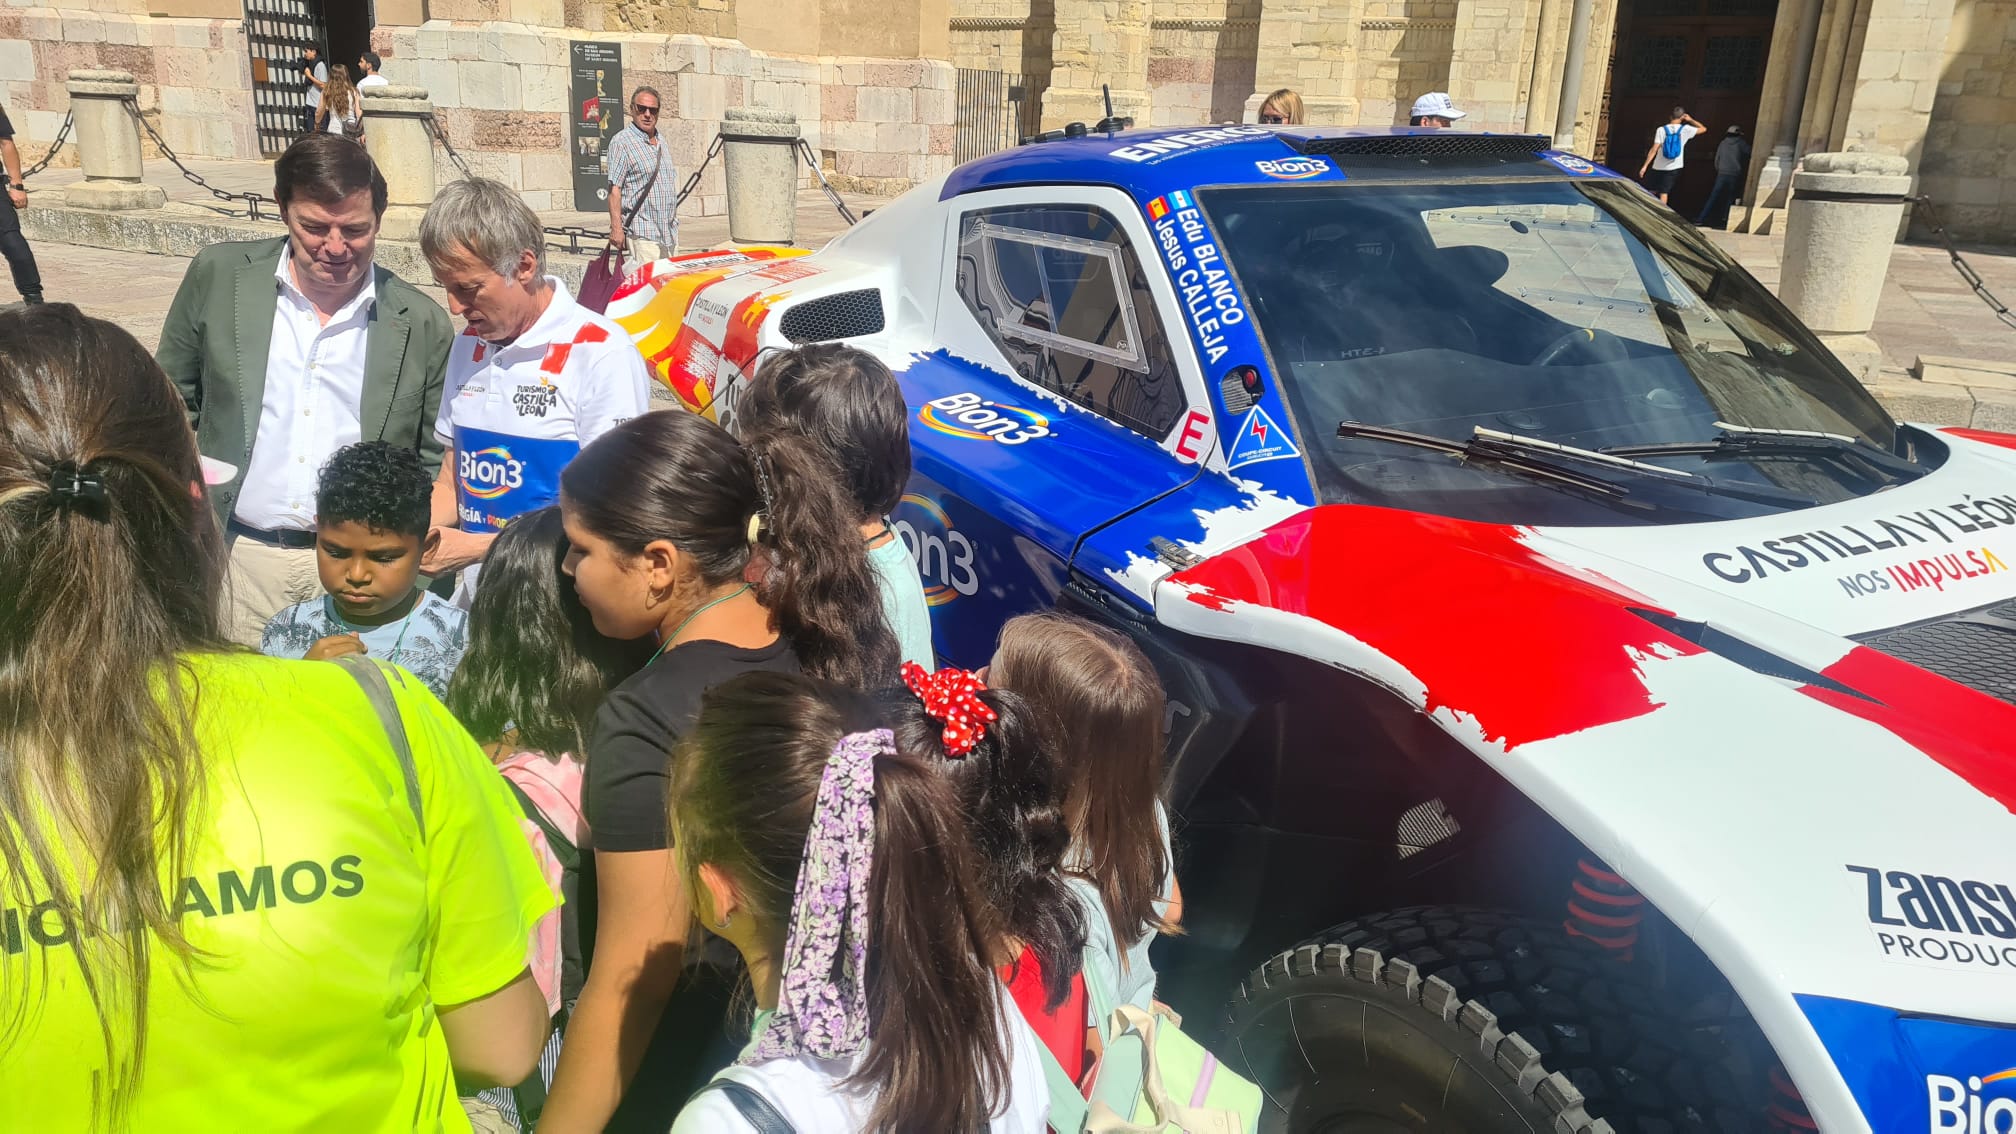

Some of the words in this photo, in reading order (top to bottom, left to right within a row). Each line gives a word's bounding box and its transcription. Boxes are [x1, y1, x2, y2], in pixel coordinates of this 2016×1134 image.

[1255, 158, 1330, 175] Bion3
[1155, 219, 1188, 271] Jesus
[1179, 269, 1229, 365] CALLEJA
[1176, 208, 1204, 243] Edu
[1194, 243, 1244, 326] BLANCO
[513, 393, 557, 407] CASTILLA
[517, 384, 547, 393] TURISMO
[927, 392, 1051, 446] Bion3
[1176, 411, 1210, 461] E
[460, 450, 523, 488] Bion3
[894, 519, 979, 596] on3
[1702, 518, 1928, 584] CASTILLA
[1896, 511, 1953, 543] Y
[1837, 569, 1890, 599] NOS
[1885, 547, 2008, 593] IMPULSA
